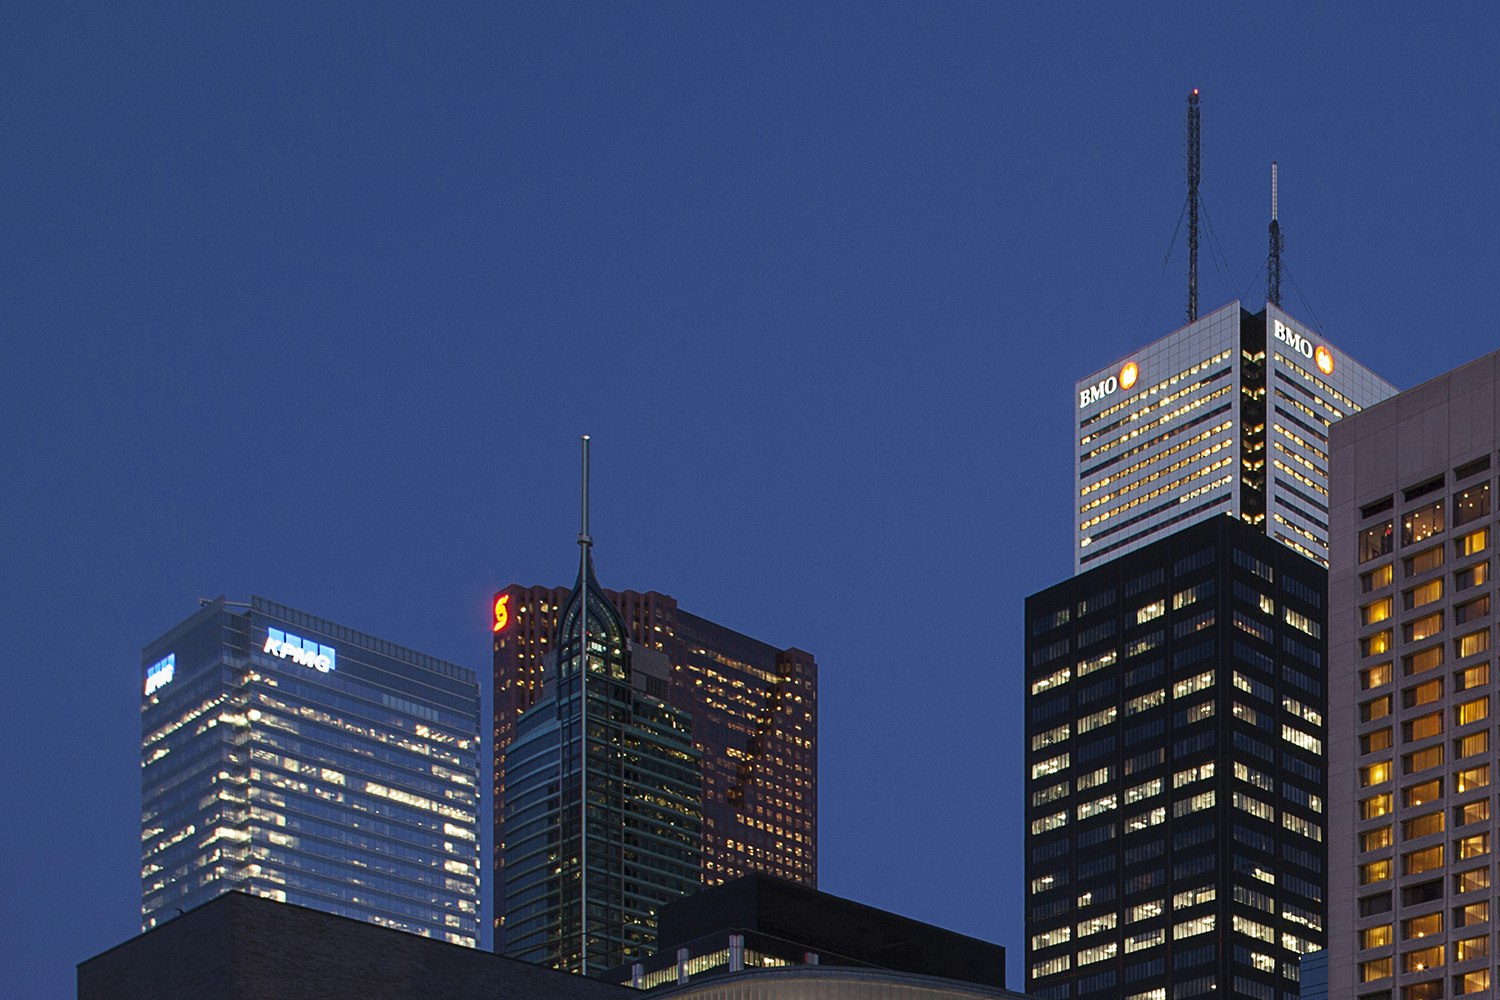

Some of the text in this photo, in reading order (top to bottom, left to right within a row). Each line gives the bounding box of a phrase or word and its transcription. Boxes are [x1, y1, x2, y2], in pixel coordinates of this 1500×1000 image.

[1273, 319, 1314, 360] BMO
[1079, 375, 1118, 409] BMO
[263, 636, 332, 673] KPMG
